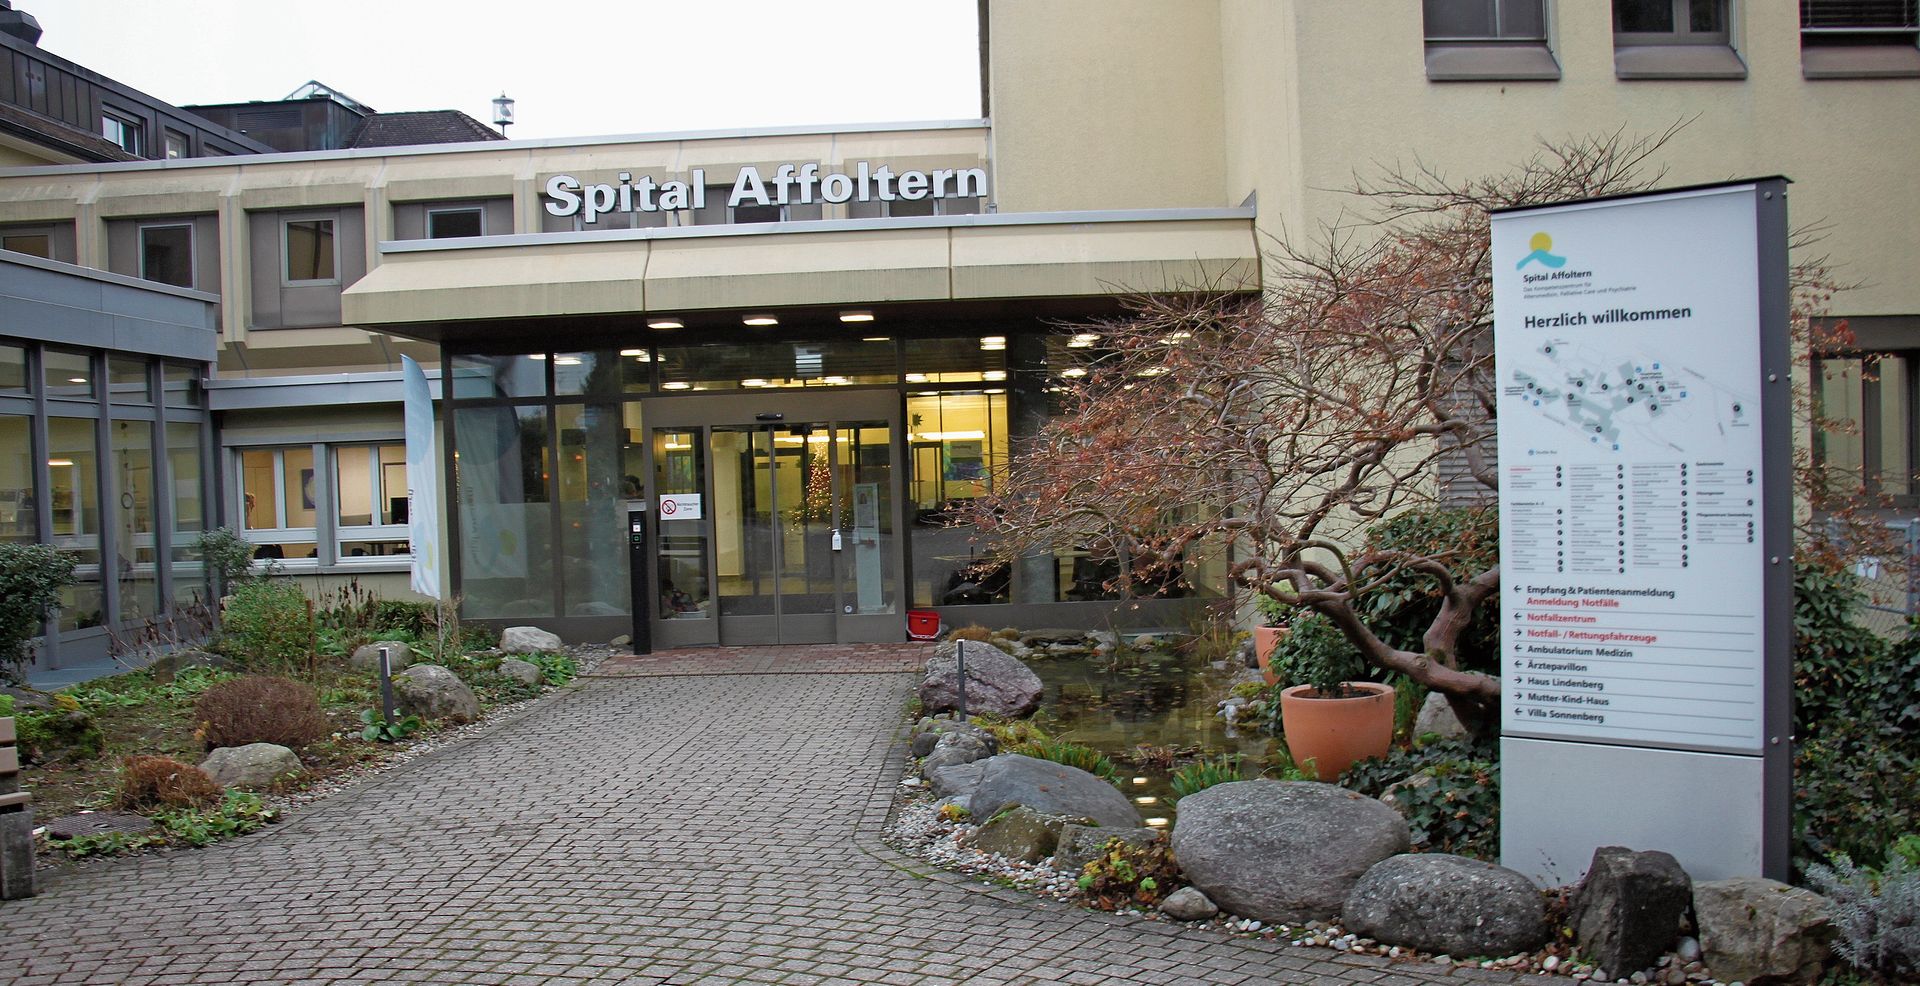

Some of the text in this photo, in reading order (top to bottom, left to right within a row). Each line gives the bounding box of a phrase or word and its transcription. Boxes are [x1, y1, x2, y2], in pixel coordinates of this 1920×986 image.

[544, 161, 988, 223] Spital Affoltern
[1523, 269, 1592, 284] Spital Affoltern
[1525, 307, 1692, 329] Herzlich willkommen
[1527, 585, 1675, 599] Empfang & Patientenanmeldung
[1527, 597, 1619, 608] Anmeldung Notfälle
[1527, 613, 1596, 623] Notfallzentrum
[1569, 631, 1657, 643] Rettungsfahrzeuge
[1527, 645, 1633, 658] Ambulatorium Medizin
[1527, 659, 1587, 672] Ärztepavillon
[1527, 677, 1604, 691] Haus Lindenberg
[1527, 693, 1610, 706] Mutter-Kind-Haus
[1527, 709, 1605, 723] Villa Sonnenberg
